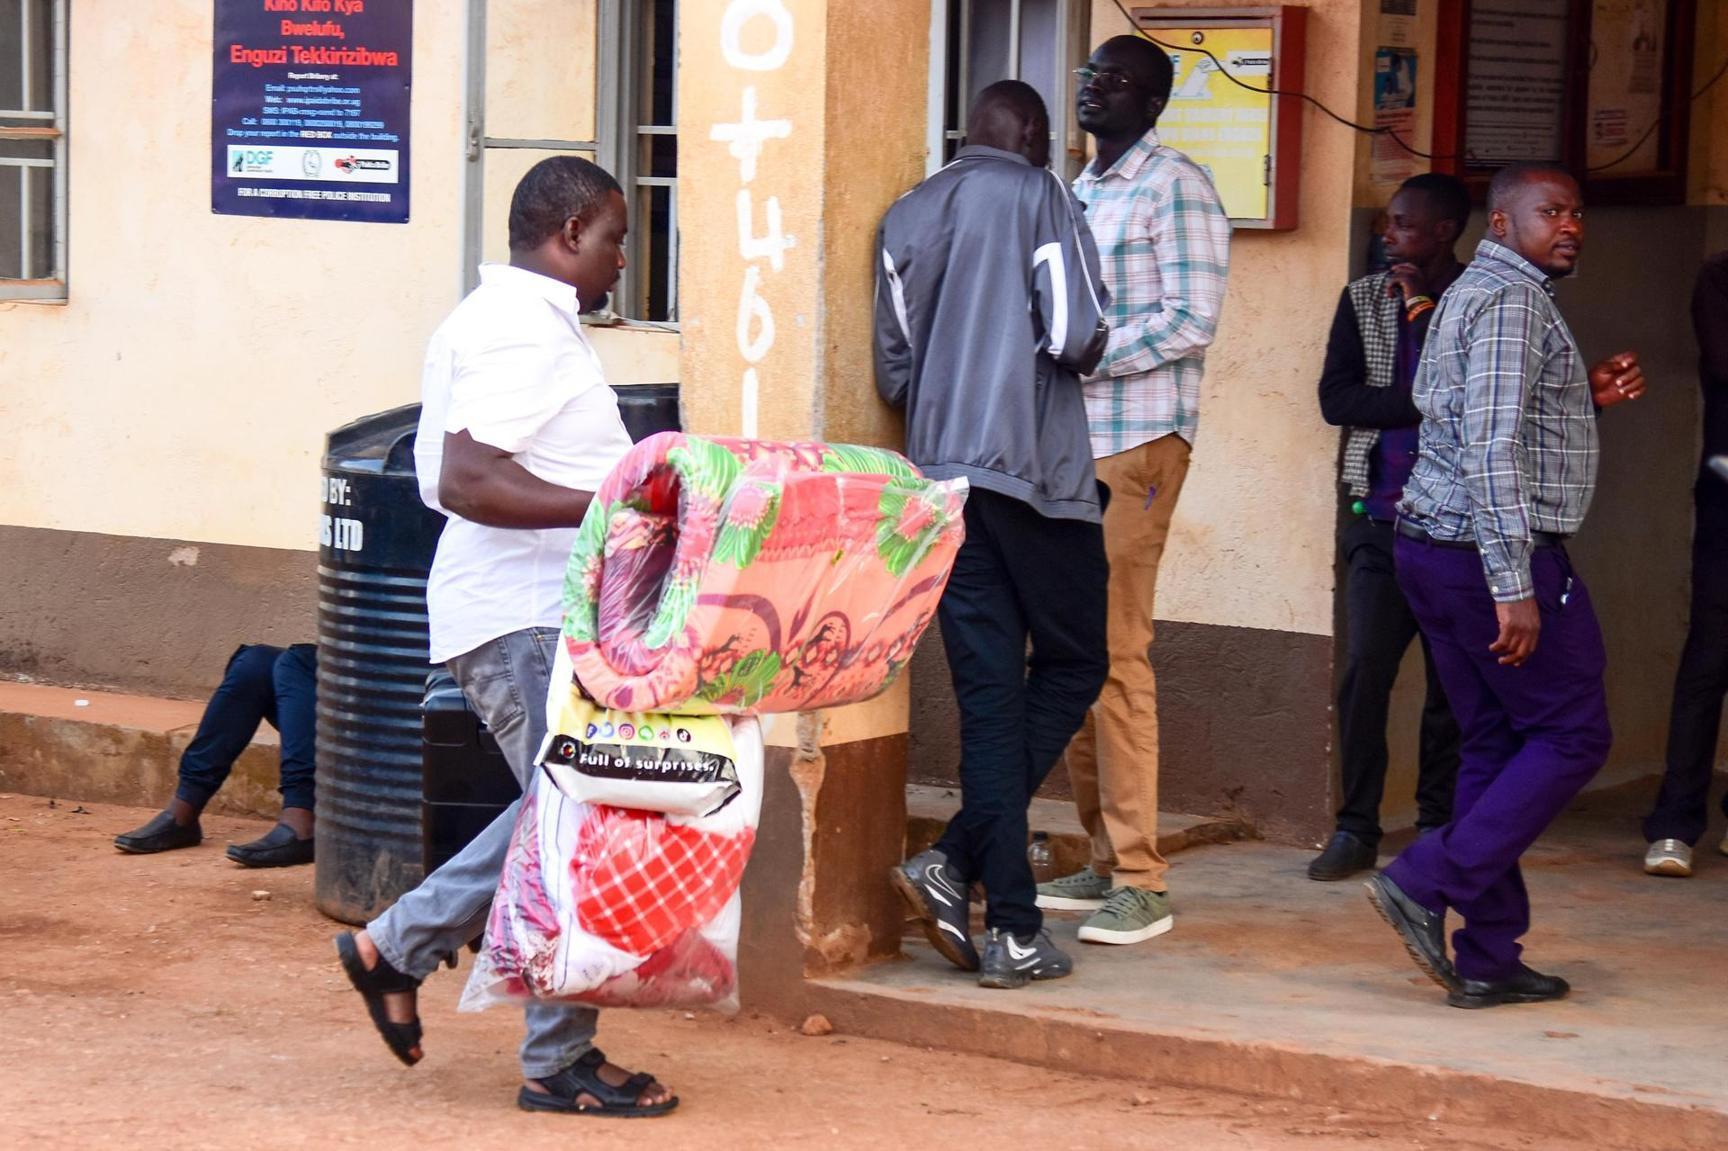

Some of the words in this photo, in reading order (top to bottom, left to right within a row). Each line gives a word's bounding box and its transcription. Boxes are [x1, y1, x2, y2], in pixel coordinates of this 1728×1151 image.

[335, 0, 364, 15] Kya
[281, 19, 345, 39] Bwelufu,
[230, 44, 287, 67] Enguzi
[290, 46, 398, 66] Tekkirizibwa
[246, 151, 273, 165] DGF
[237, 187, 252, 197] FOR
[259, 188, 303, 199] CORRUPTION
[303, 190, 322, 200] FREE
[322, 191, 348, 201] POLICE
[348, 192, 392, 202] INSTITUTION
[329, 478, 351, 506] BY:
[334, 517, 364, 552] LTD
[579, 753, 610, 766] Full
[614, 755, 630, 768] of
[636, 759, 714, 773] surprises.
